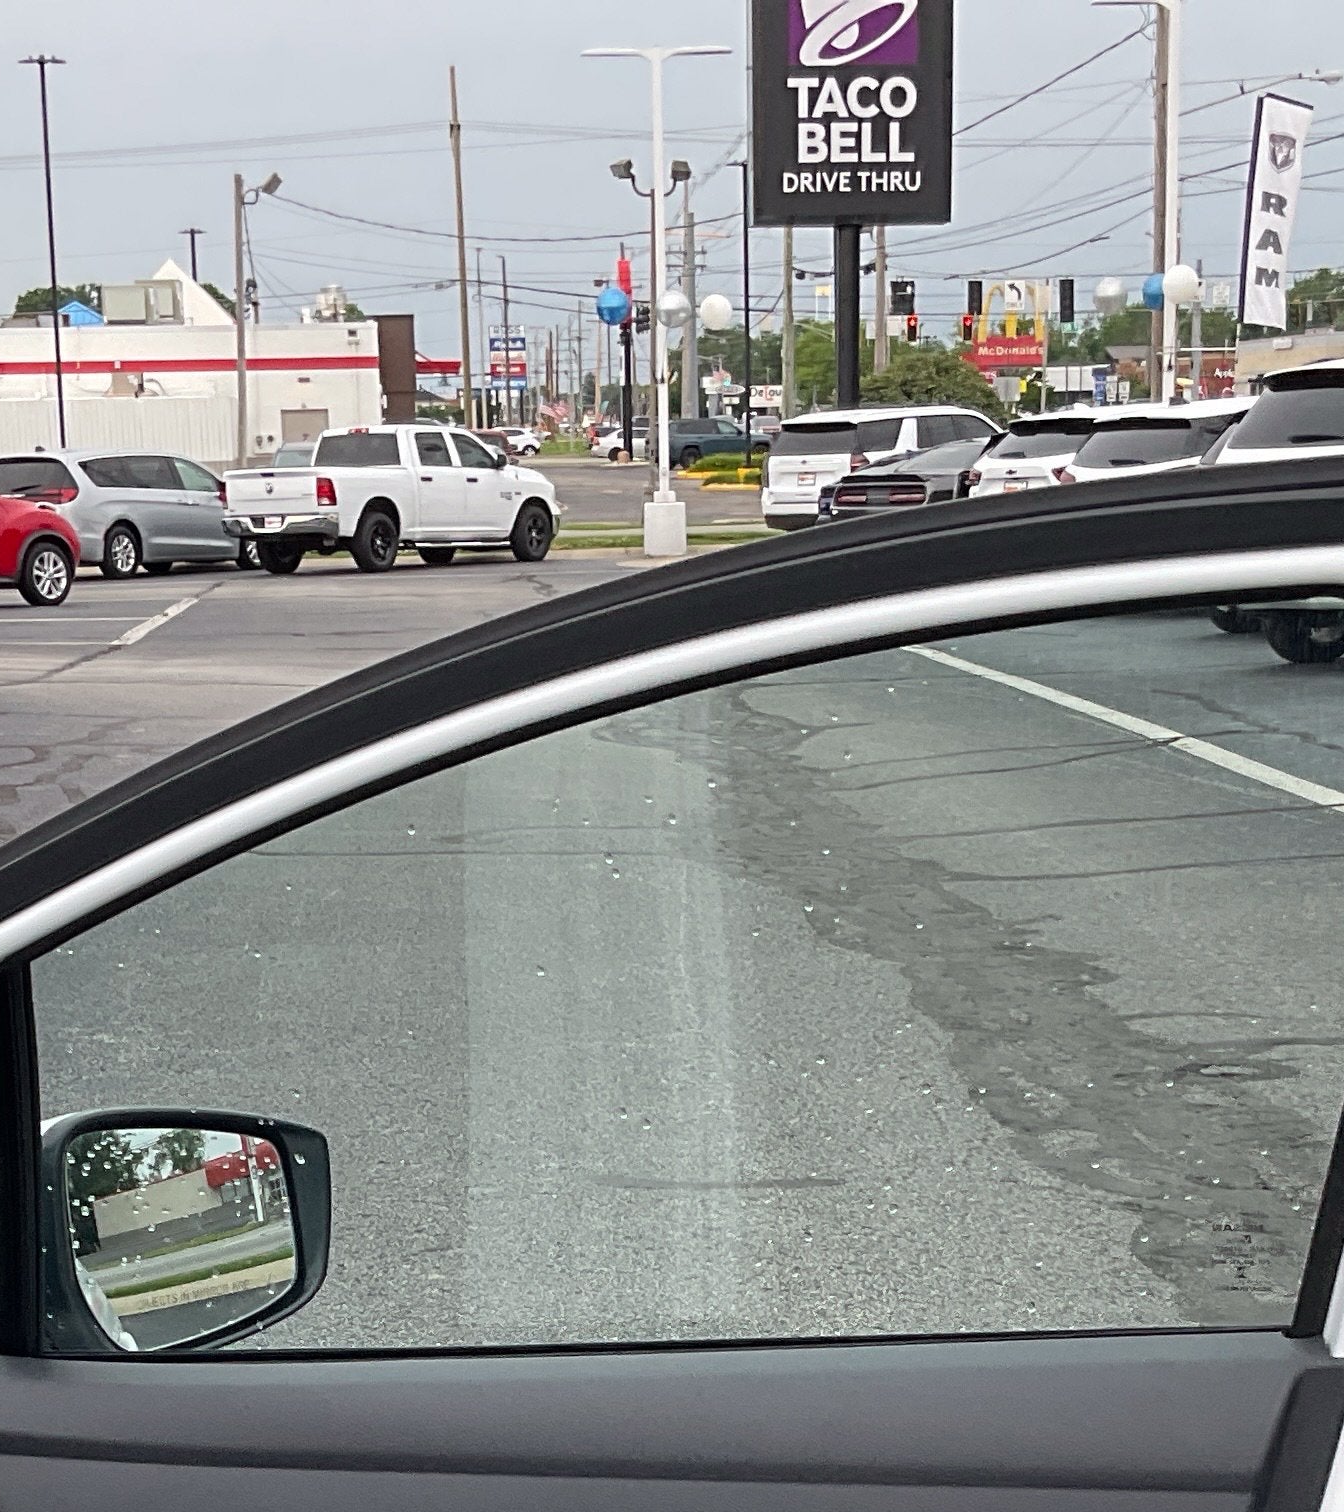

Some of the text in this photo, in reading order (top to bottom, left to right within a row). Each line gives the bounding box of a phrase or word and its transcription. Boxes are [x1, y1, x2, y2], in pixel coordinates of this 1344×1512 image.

[786, 76, 918, 119] TACO
[797, 121, 915, 164] BELL
[782, 170, 922, 194] DRIVE THRU
[1255, 191, 1288, 289] RAM
